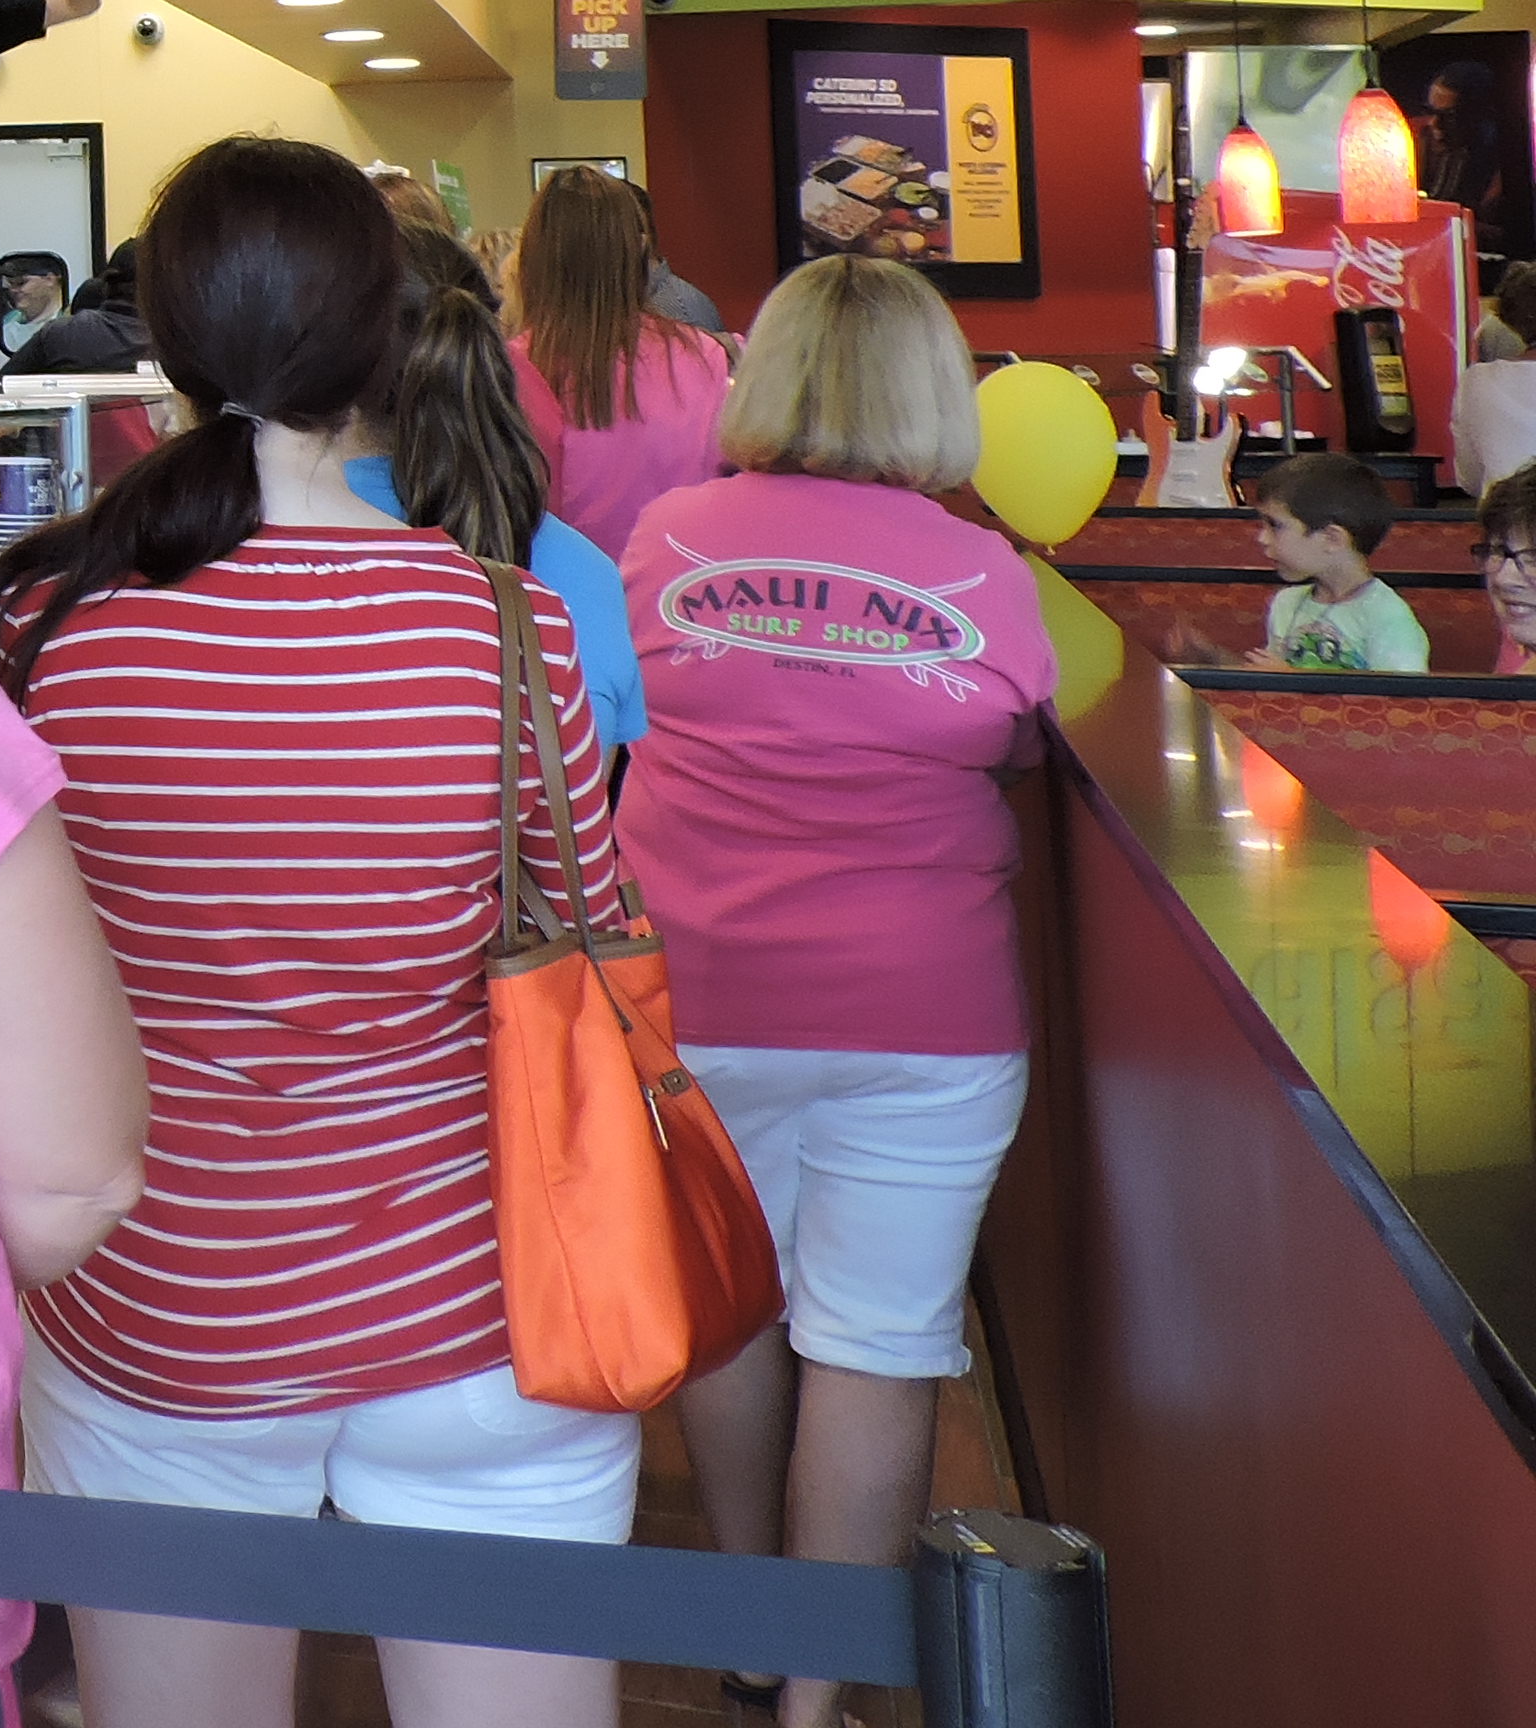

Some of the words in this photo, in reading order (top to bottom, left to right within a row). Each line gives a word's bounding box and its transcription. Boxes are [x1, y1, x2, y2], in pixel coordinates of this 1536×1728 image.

[582, 16, 618, 33] UP
[571, 33, 630, 49] HERE
[681, 576, 830, 622] MAUI
[863, 590, 960, 648] NIX
[728, 612, 802, 637] SURF
[823, 622, 910, 653] SHOP
